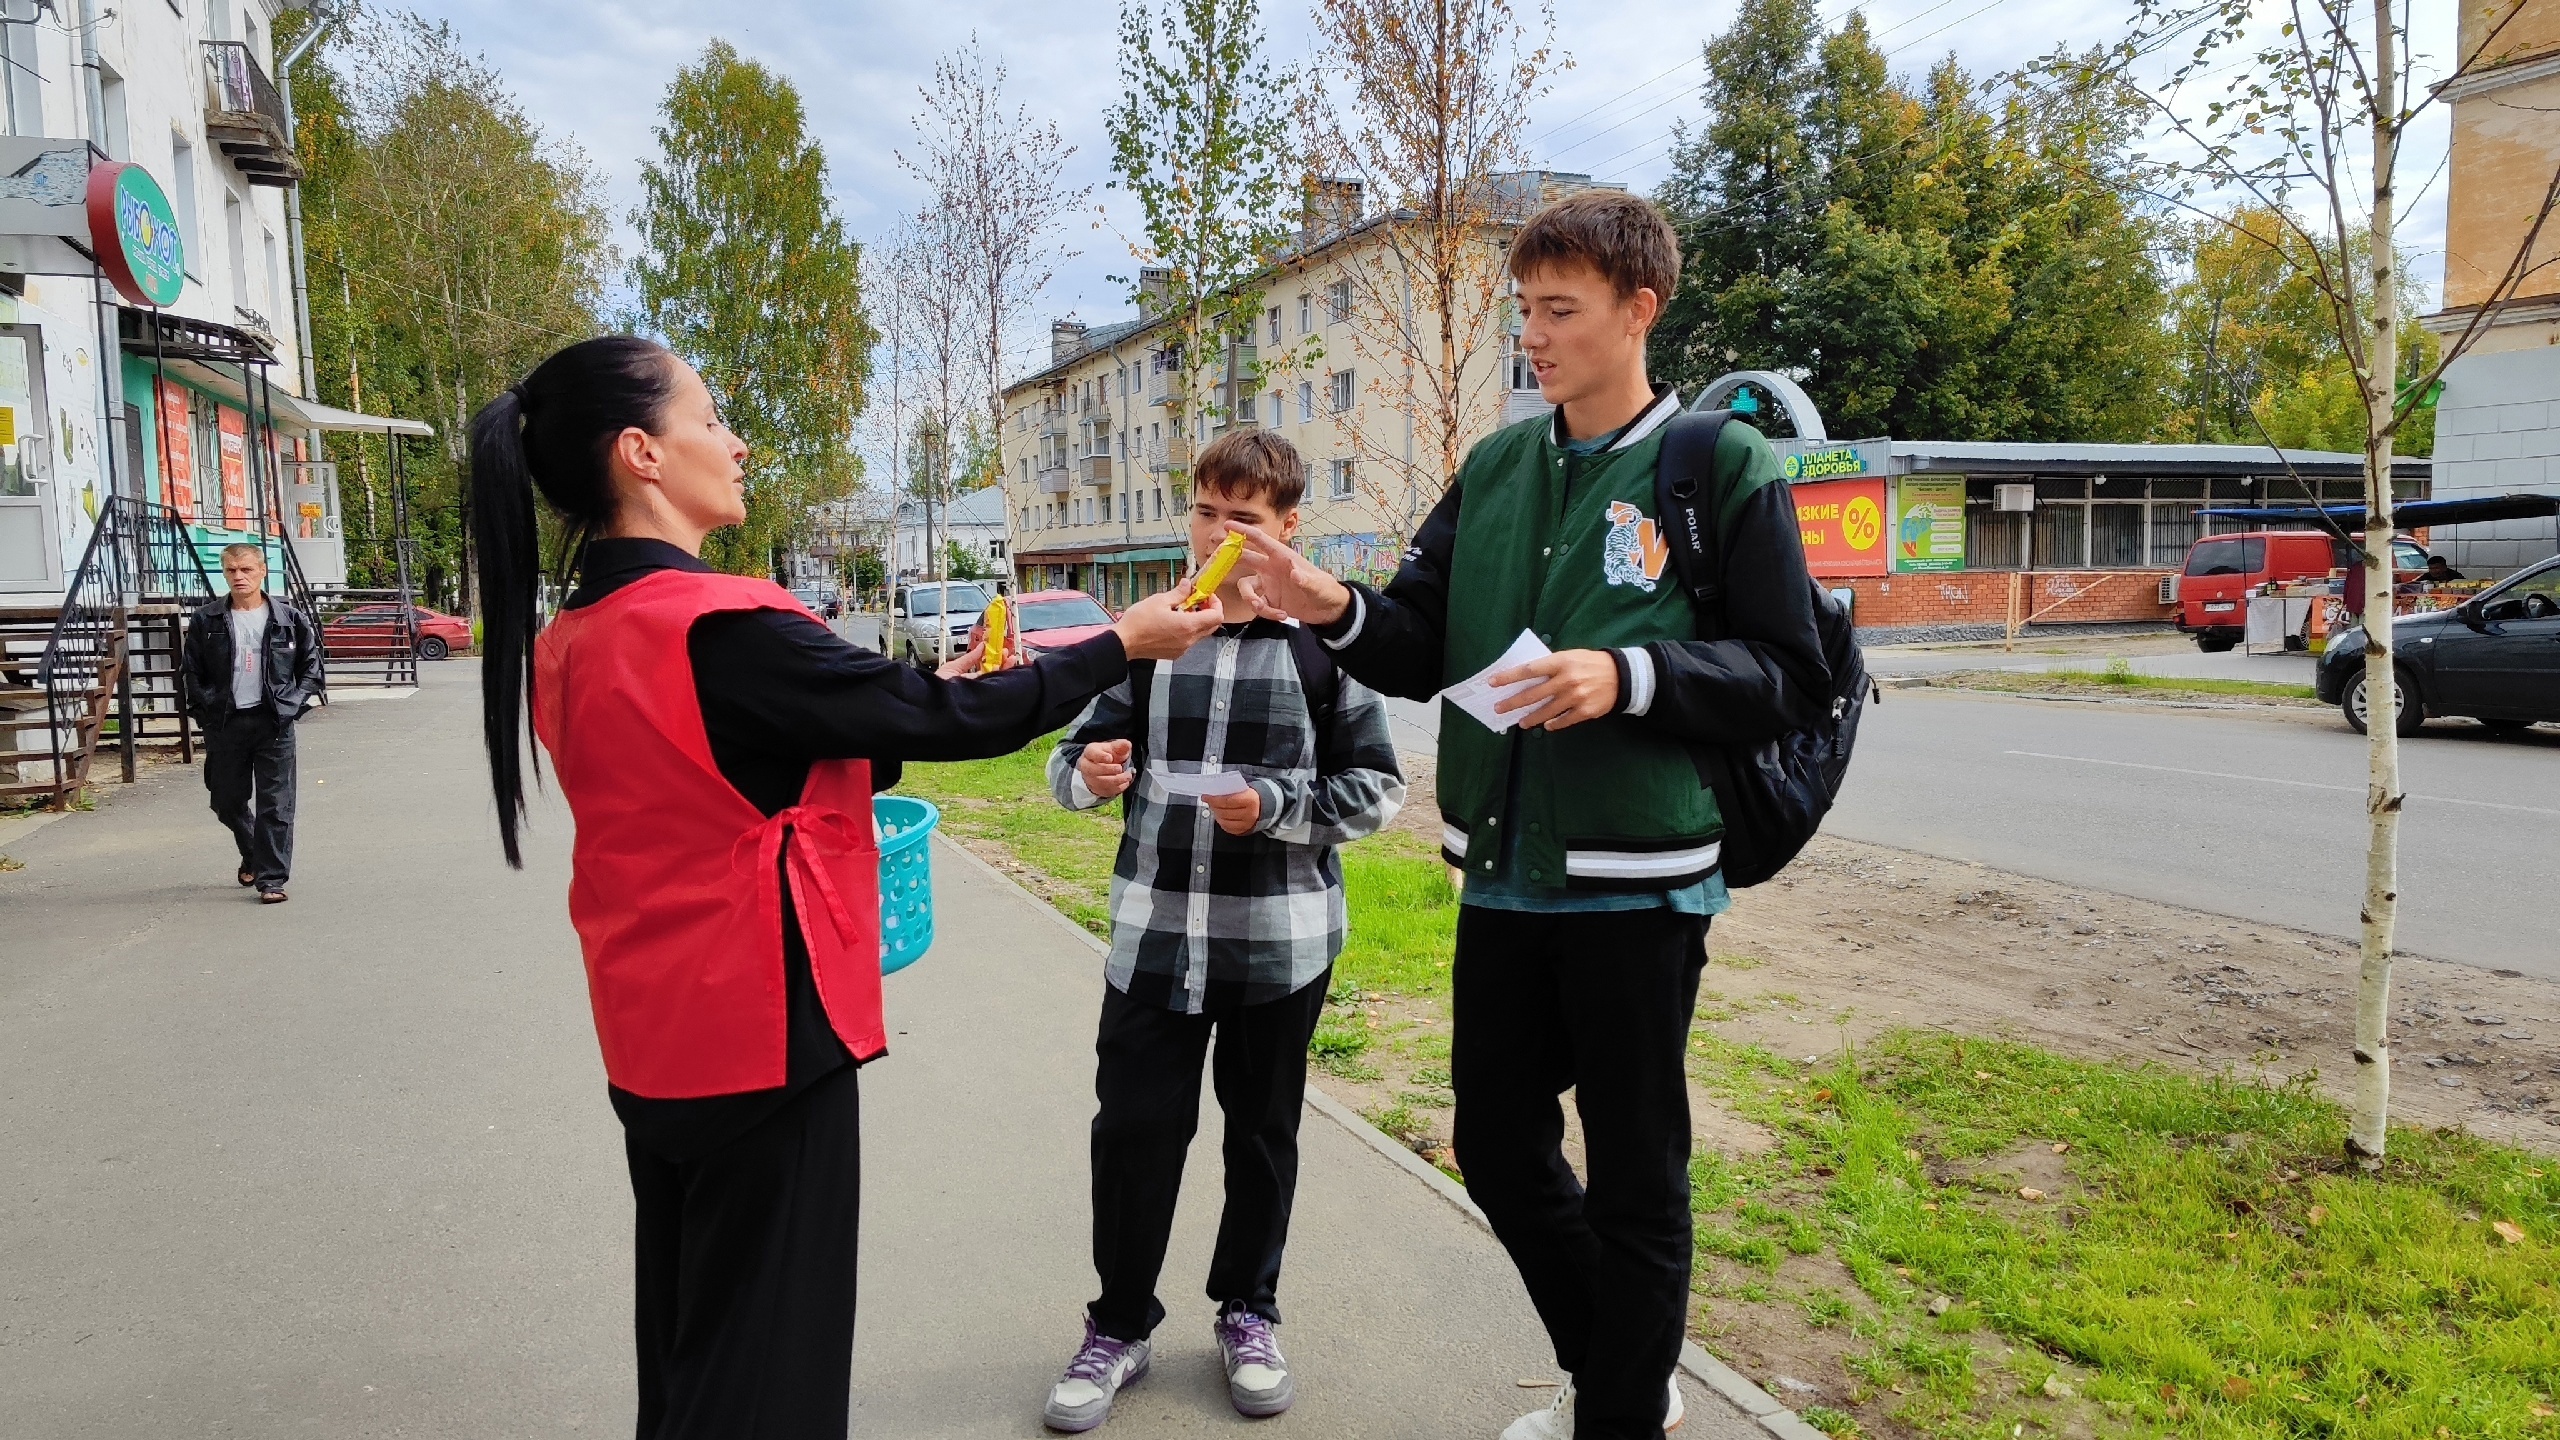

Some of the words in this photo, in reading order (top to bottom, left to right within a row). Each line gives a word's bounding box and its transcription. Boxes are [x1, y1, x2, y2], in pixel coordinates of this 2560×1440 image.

[1801, 449, 1853, 465] ПЛАНЕТА
[1801, 460, 1861, 478] ЗДОРОВЬЯ
[1796, 503, 1840, 521] ИЗКИЕ
[1685, 507, 1701, 551] POLAR
[1801, 529, 1825, 545] НЫ
